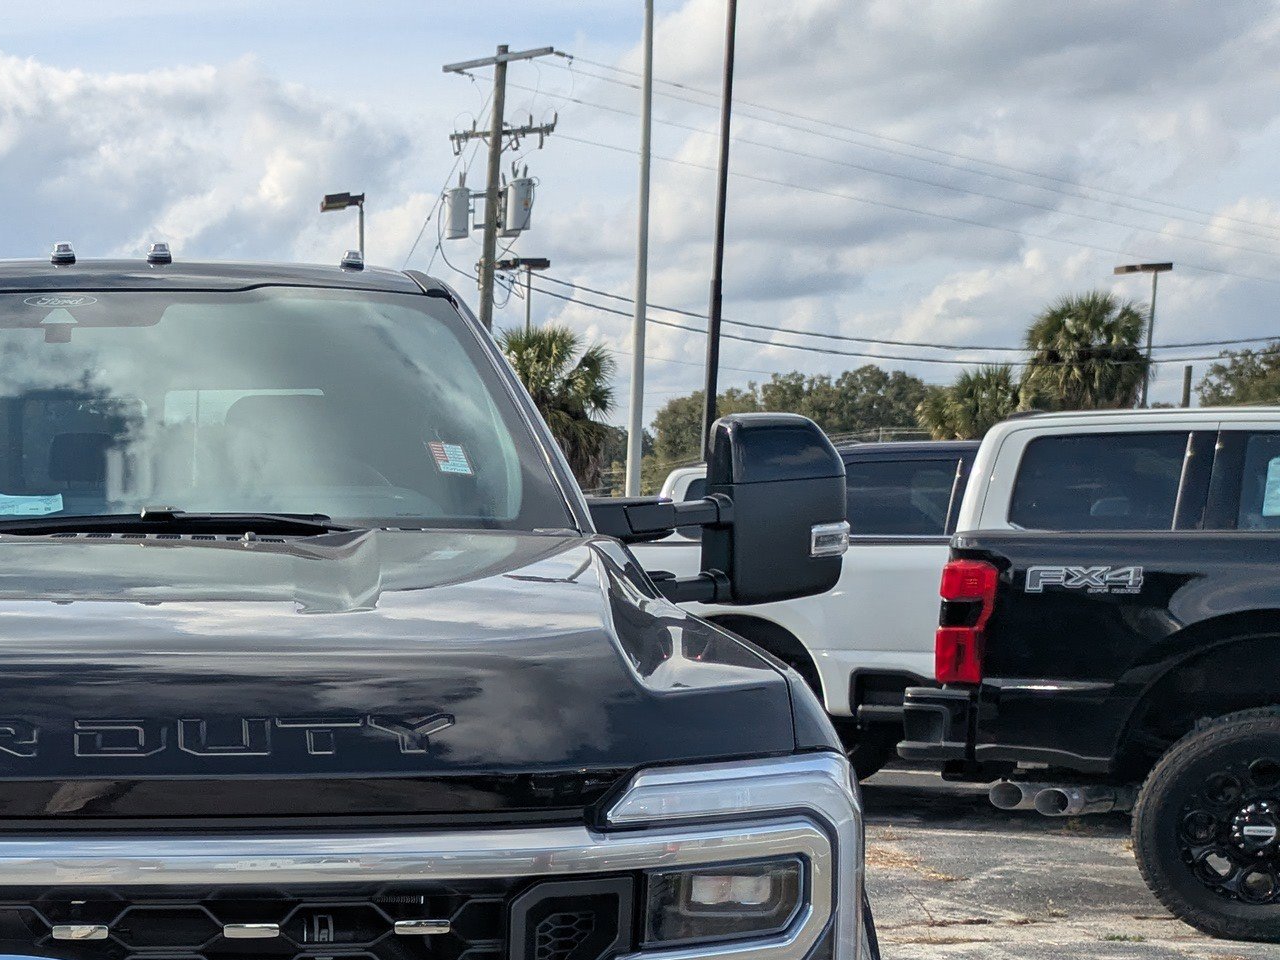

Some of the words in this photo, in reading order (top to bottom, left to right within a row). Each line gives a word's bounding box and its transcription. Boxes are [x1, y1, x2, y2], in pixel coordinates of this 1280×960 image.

[37, 297, 84, 305] Ford
[1025, 566, 1143, 593] FX4
[73, 713, 456, 756] DUTY
